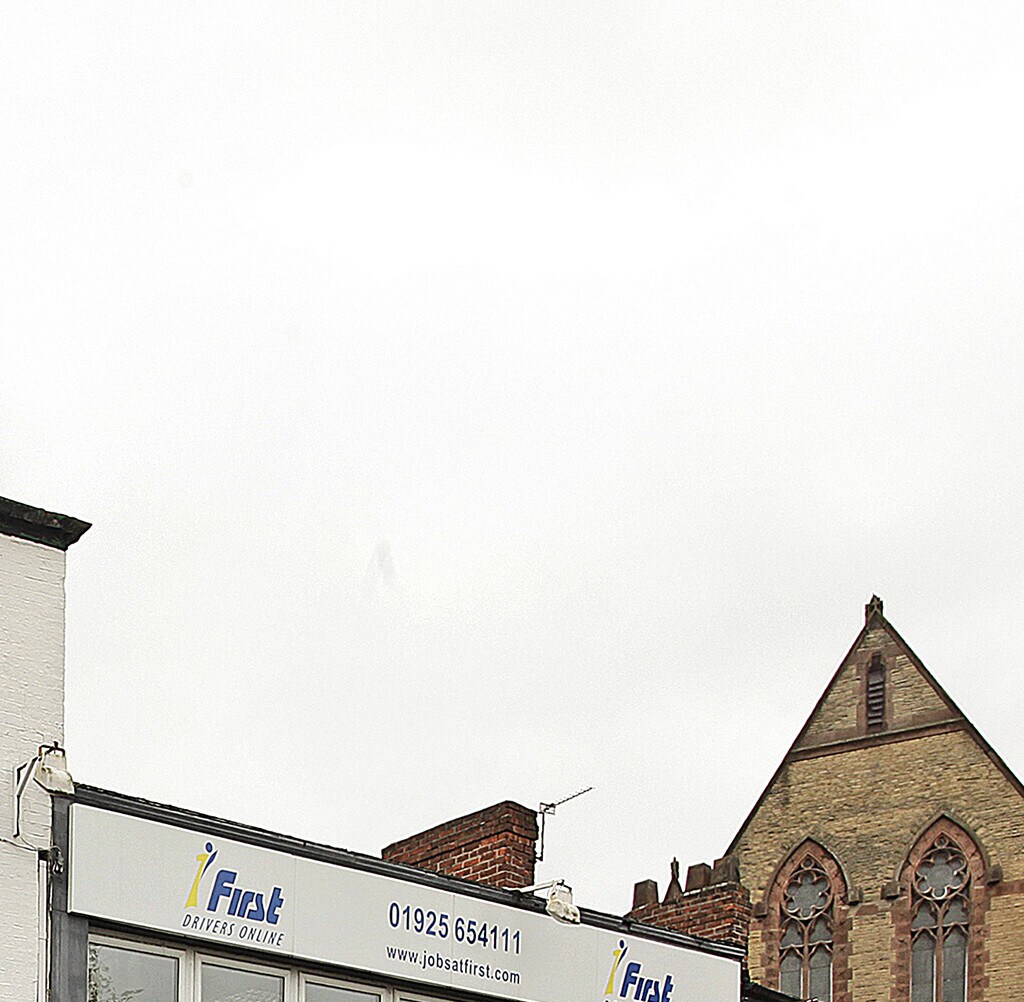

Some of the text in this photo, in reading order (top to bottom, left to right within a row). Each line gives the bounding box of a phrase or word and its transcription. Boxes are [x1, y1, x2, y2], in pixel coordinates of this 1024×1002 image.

[207, 869, 284, 925] First
[182, 914, 284, 946] DRIVERS ONLINE
[389, 902, 522, 955] 01925 654111
[386, 946, 521, 985] www.jobsatfirst.com
